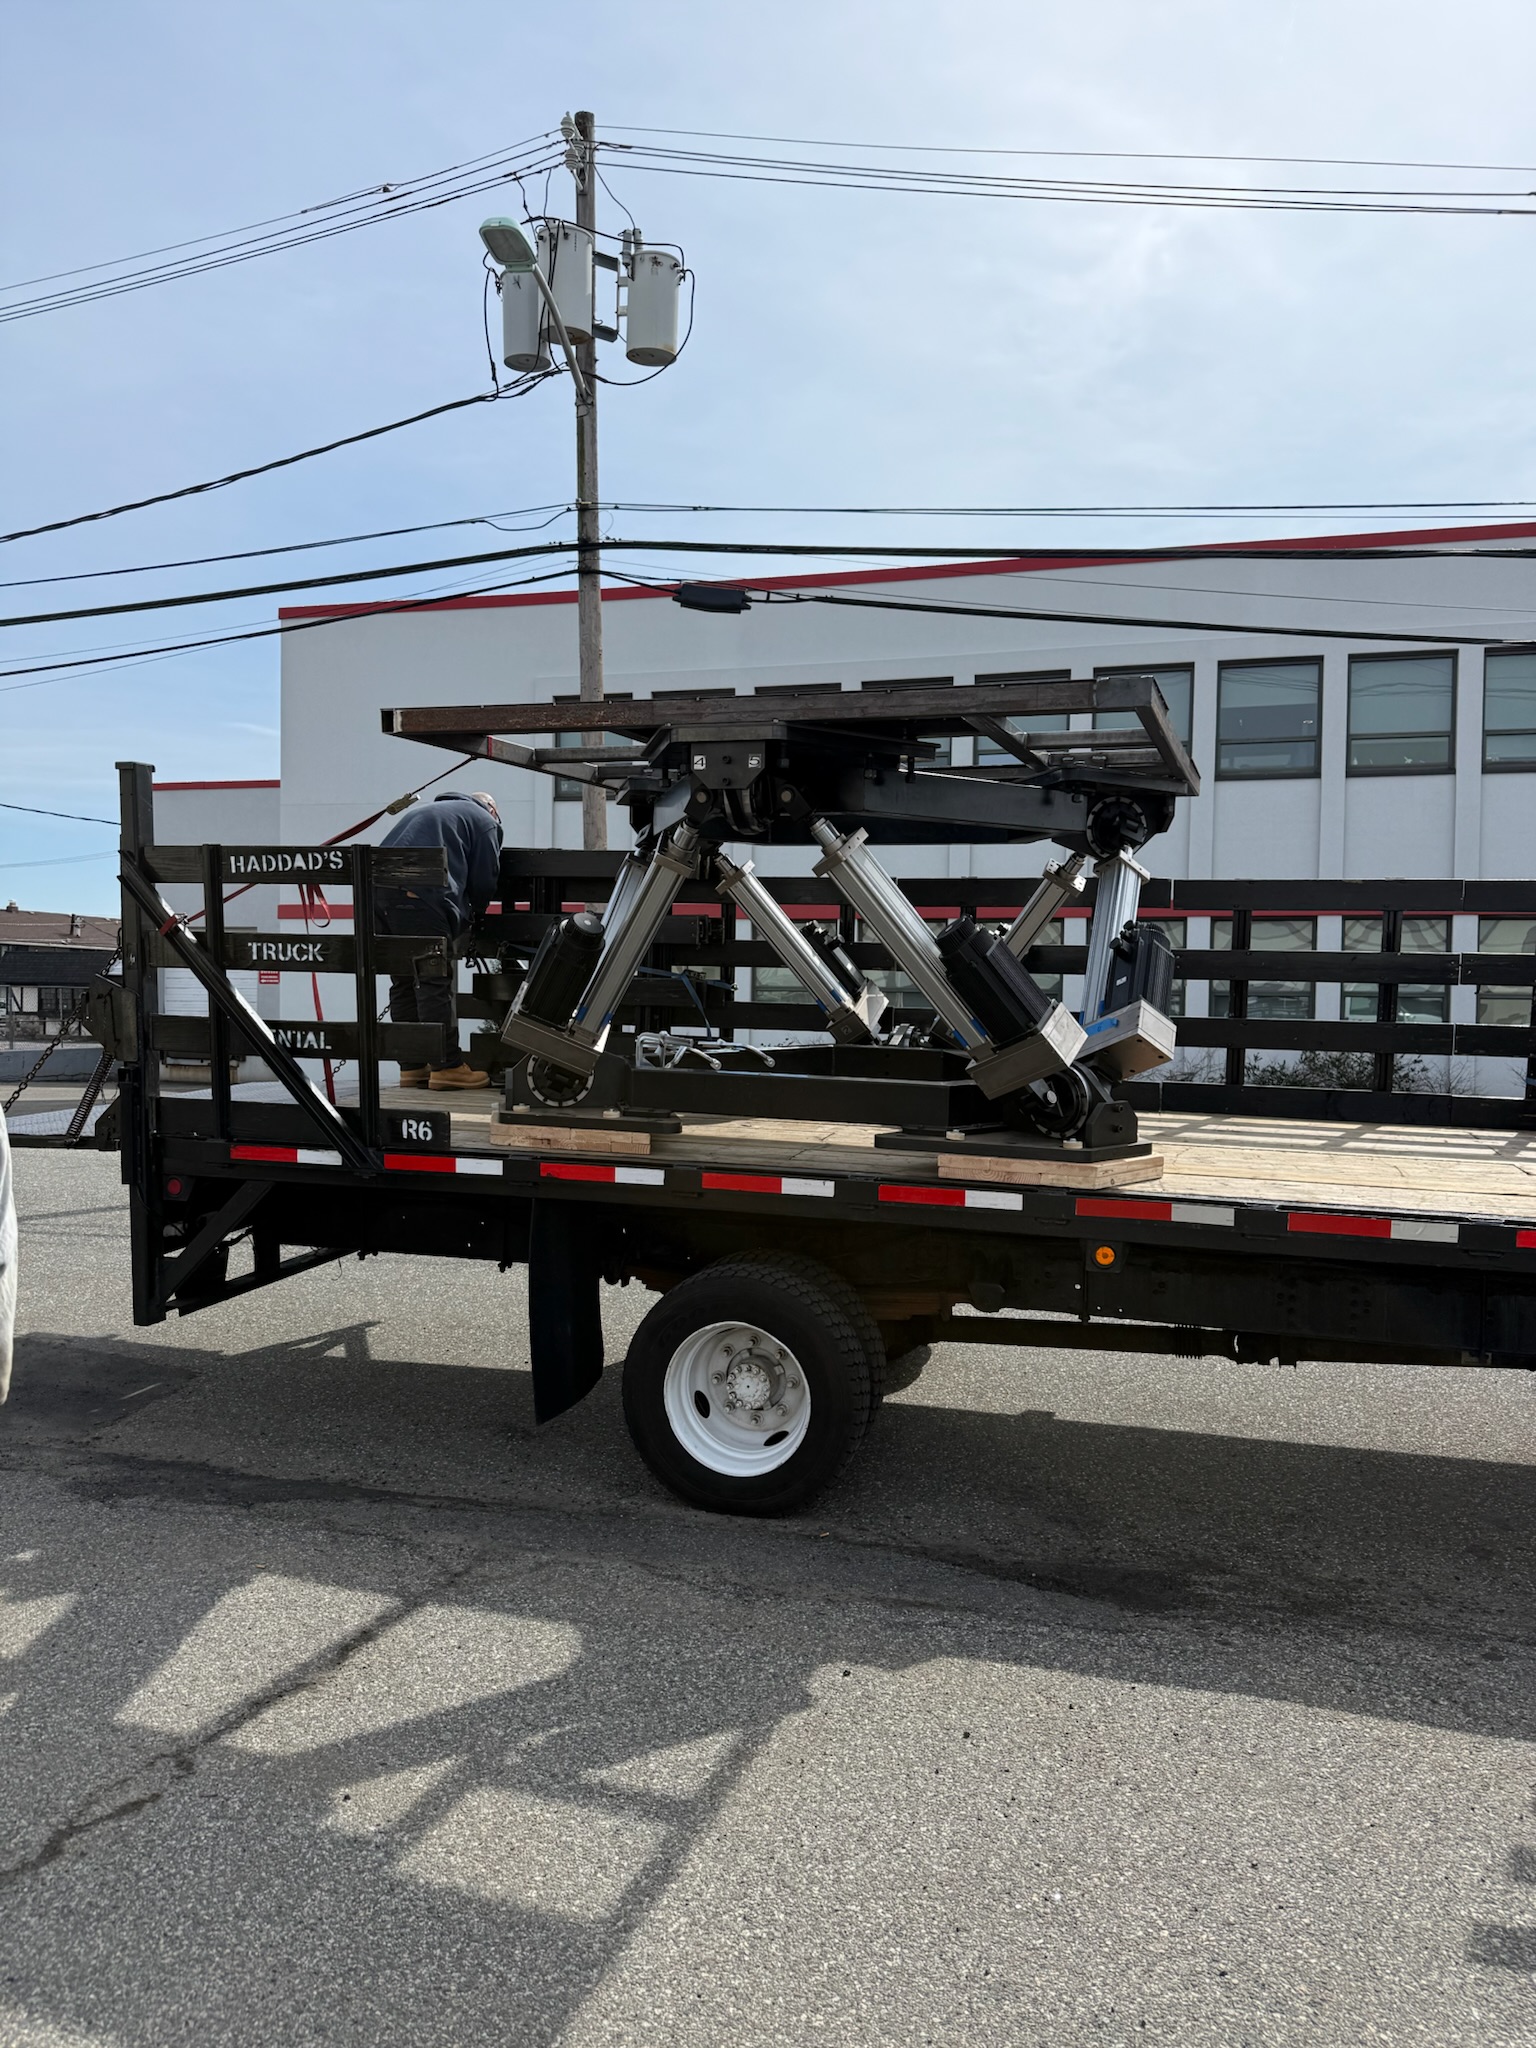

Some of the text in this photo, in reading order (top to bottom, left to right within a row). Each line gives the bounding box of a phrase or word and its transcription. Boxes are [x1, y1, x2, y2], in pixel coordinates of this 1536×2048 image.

[230, 850, 344, 874] HADDAD'S
[247, 941, 324, 962] TRUCK
[270, 1028, 332, 1050] NTAL
[402, 1118, 433, 1142] R6
